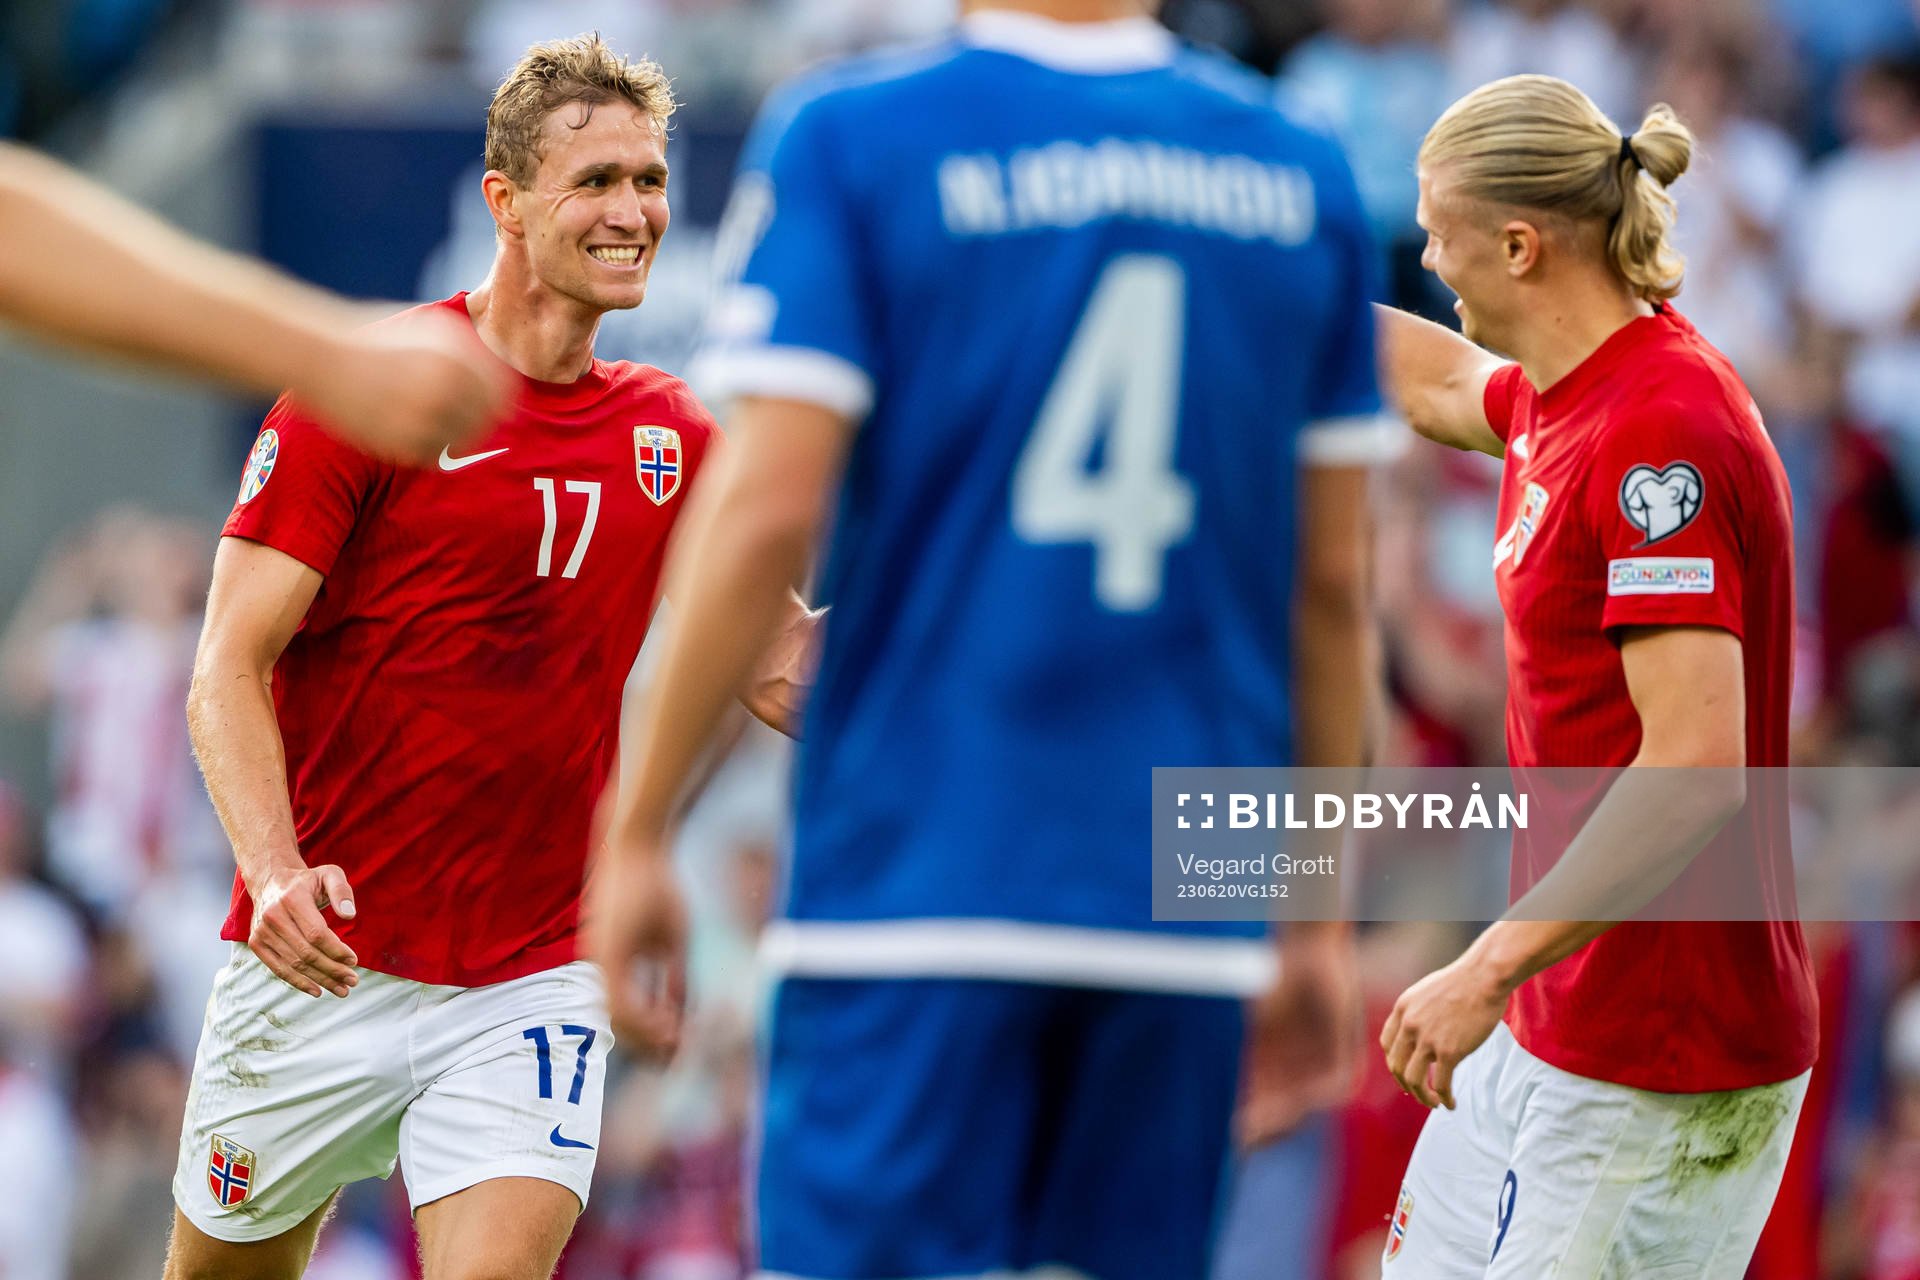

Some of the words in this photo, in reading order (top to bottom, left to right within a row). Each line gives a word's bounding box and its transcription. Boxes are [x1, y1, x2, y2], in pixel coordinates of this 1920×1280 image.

[1012, 254, 1196, 611] 4
[534, 477, 601, 578] 17
[1612, 568, 1710, 581] FOUNDATION
[523, 1024, 597, 1105] 17
[1490, 1169, 1517, 1264] 9
